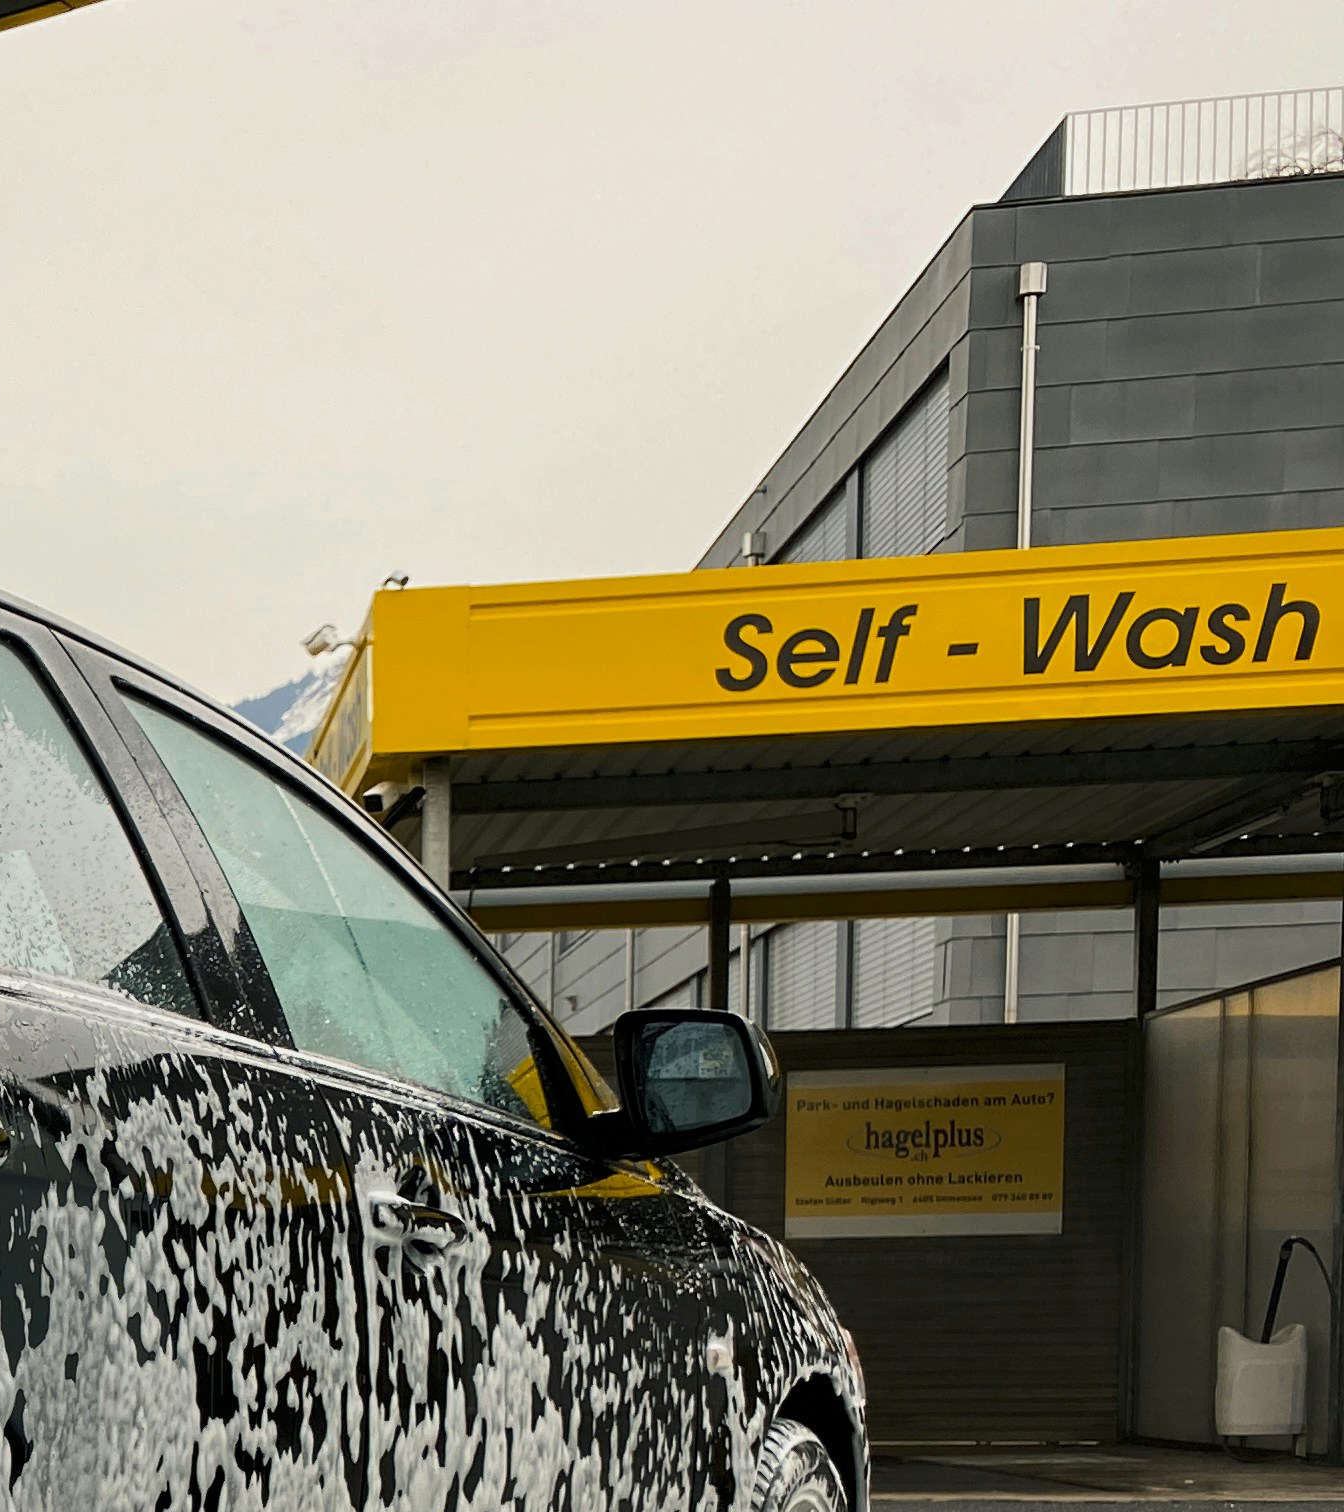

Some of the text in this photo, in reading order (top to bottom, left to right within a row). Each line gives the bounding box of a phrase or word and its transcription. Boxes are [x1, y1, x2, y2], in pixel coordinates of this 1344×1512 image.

[715, 603, 918, 692] Self
[1023, 582, 1321, 676] Wash
[796, 1092, 1055, 1112] Park- und Hagelschaden am Auto?
[865, 1120, 984, 1158] hagelplus
[825, 1171, 1023, 1187] Ausbeulen ohne Lackieren
